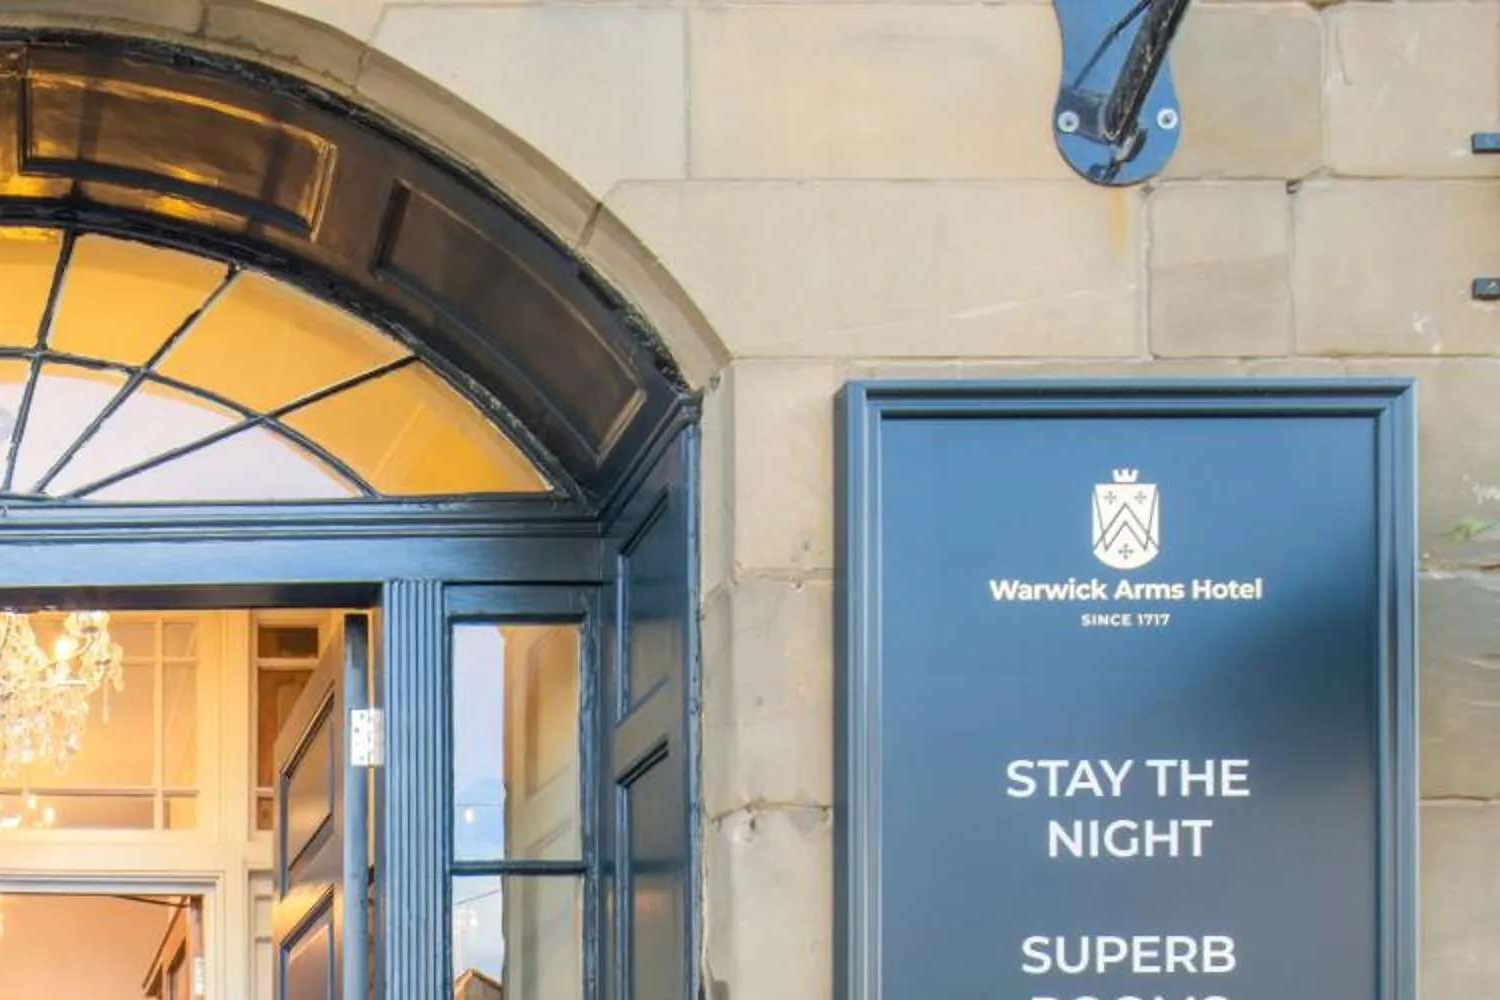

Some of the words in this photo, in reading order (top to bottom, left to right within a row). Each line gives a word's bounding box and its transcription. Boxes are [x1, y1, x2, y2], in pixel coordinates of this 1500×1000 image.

[989, 577, 1108, 601] Warwick
[1114, 579, 1185, 600] Arms
[1192, 577, 1263, 600] Hotel
[1081, 613, 1132, 627] SINCE
[1137, 613, 1171, 626] 1717
[1006, 759, 1134, 798] STAY
[1146, 759, 1250, 798] THE
[1048, 819, 1213, 858] NIGHT
[1021, 935, 1236, 974] SUPERB
